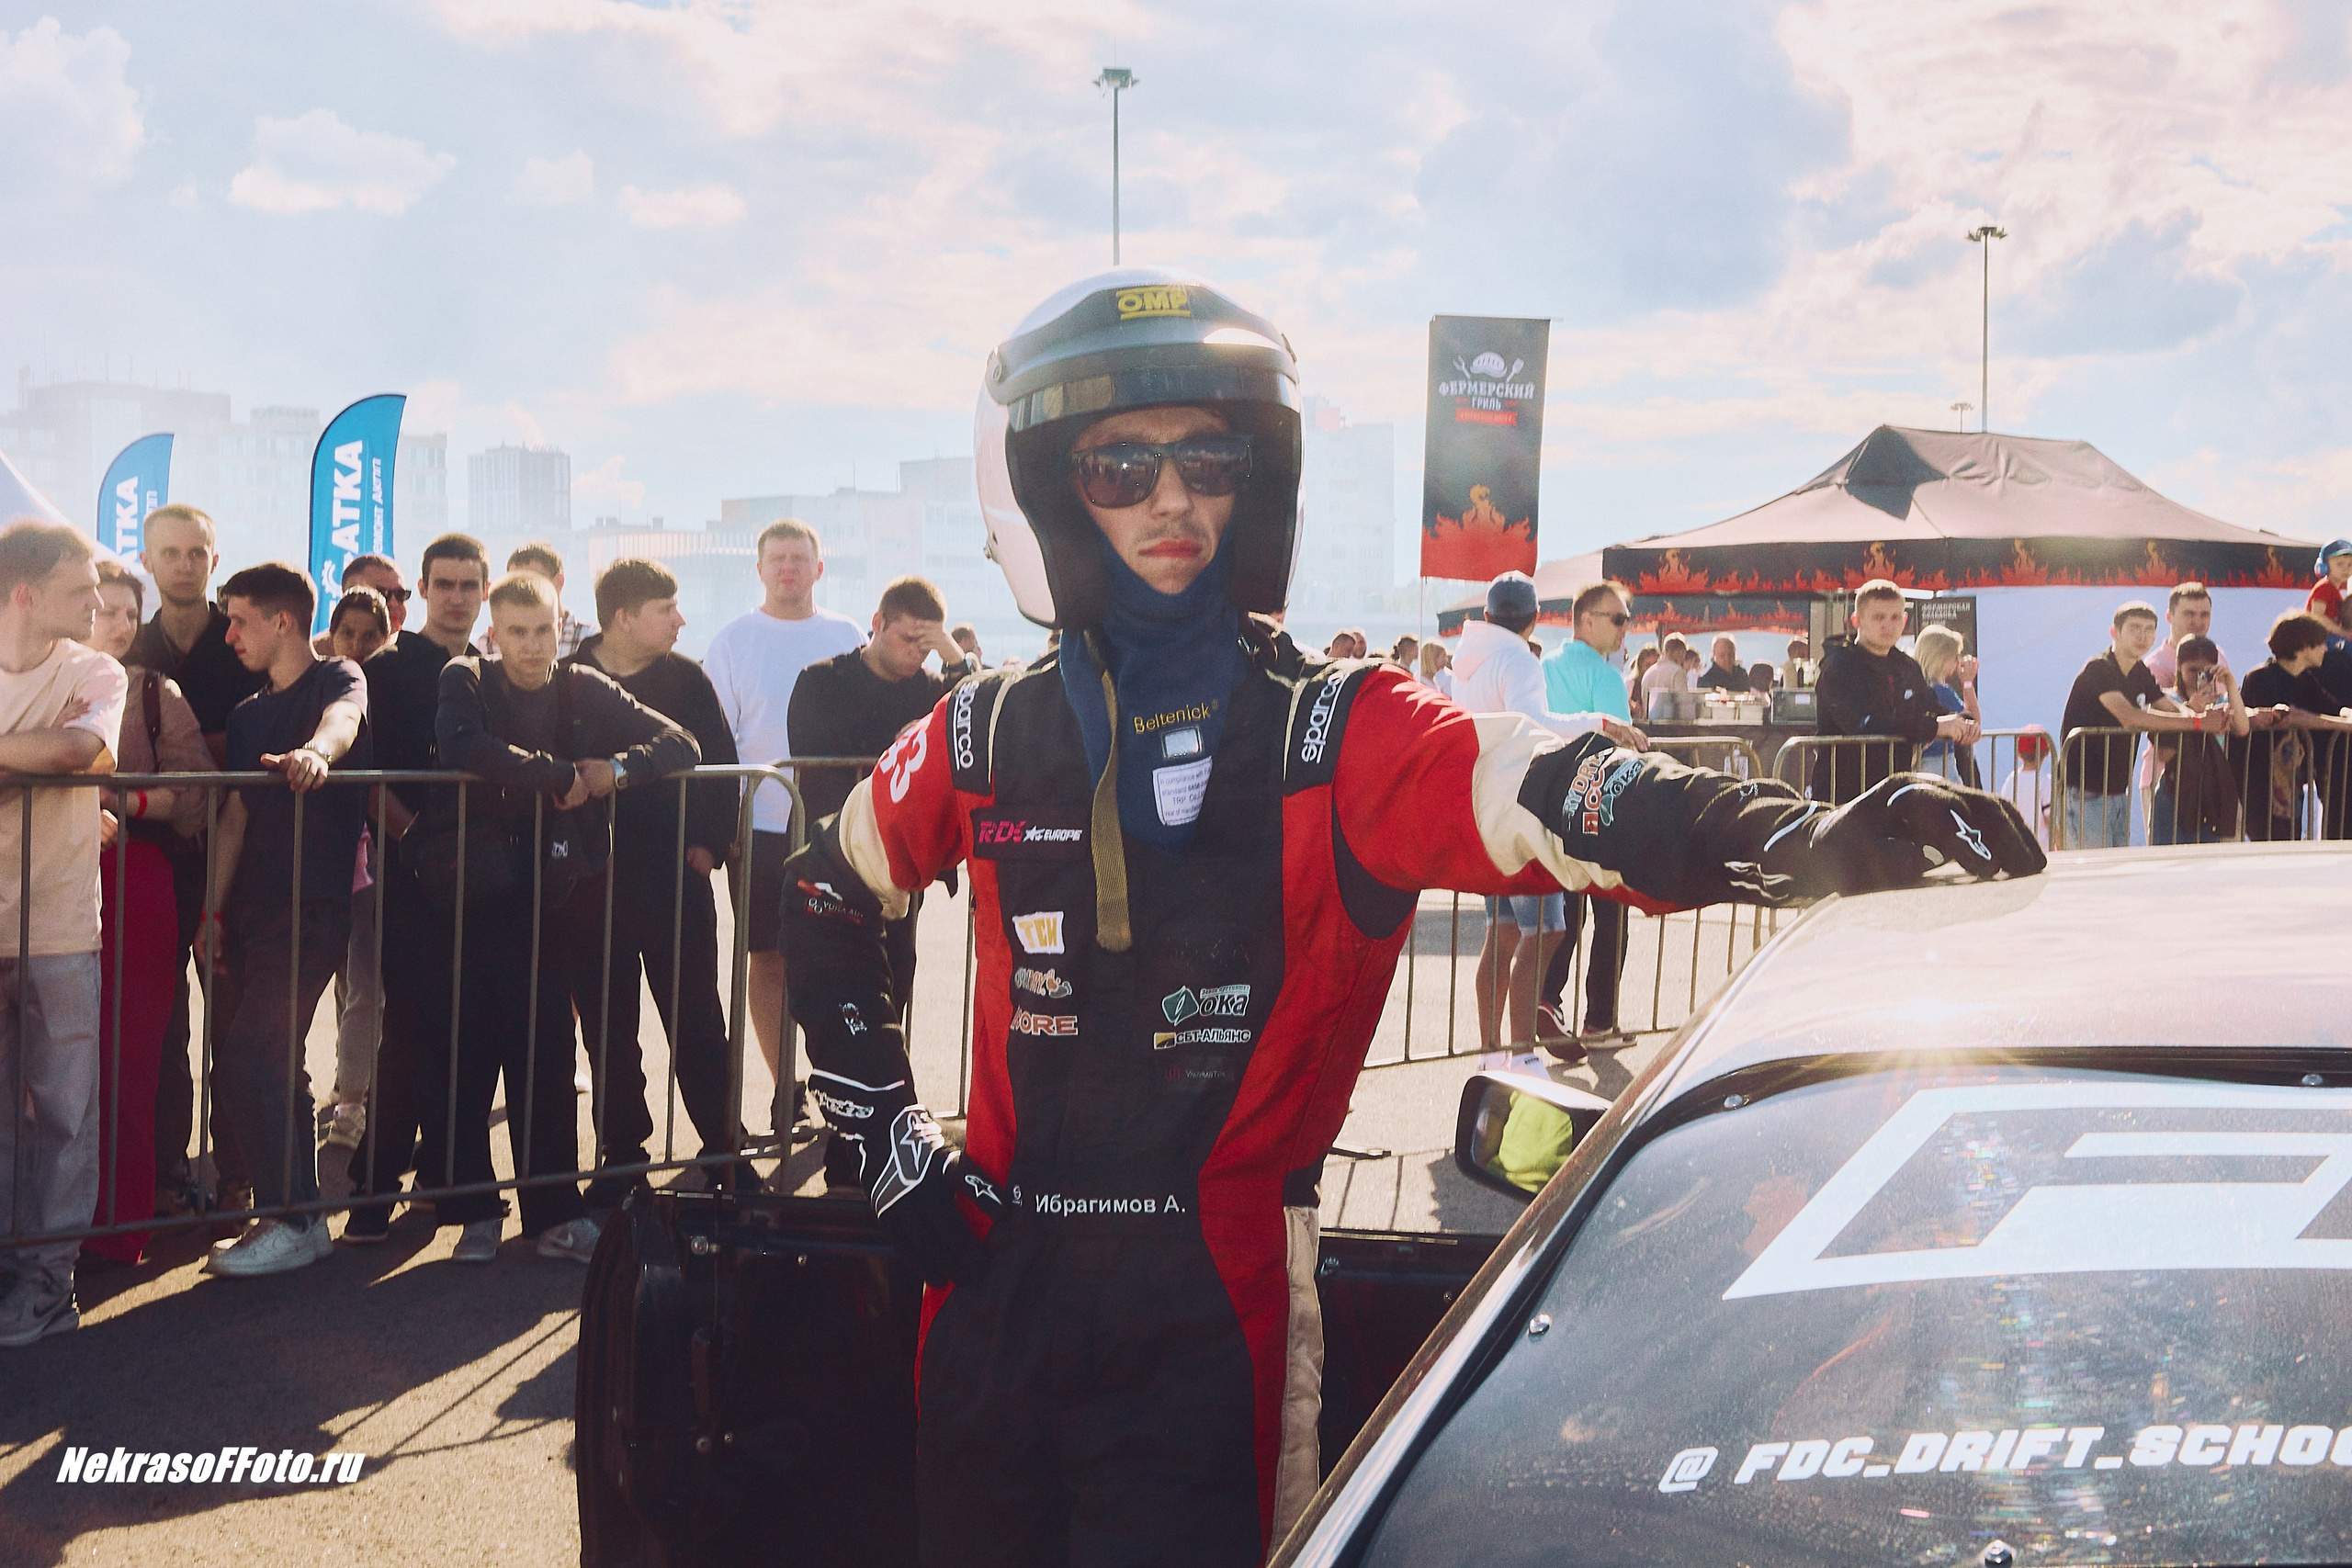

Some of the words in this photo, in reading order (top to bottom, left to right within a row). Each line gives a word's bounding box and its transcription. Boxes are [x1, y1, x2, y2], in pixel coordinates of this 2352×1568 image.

[1117, 289, 1189, 315] OMP
[1438, 379, 1534, 400] ФЕРМЕРСКИЙ
[1472, 396, 1501, 411] ГРИЛЬ
[1035, 1193, 1157, 1217] Ибрагимов
[1163, 1194, 1186, 1213] А.
